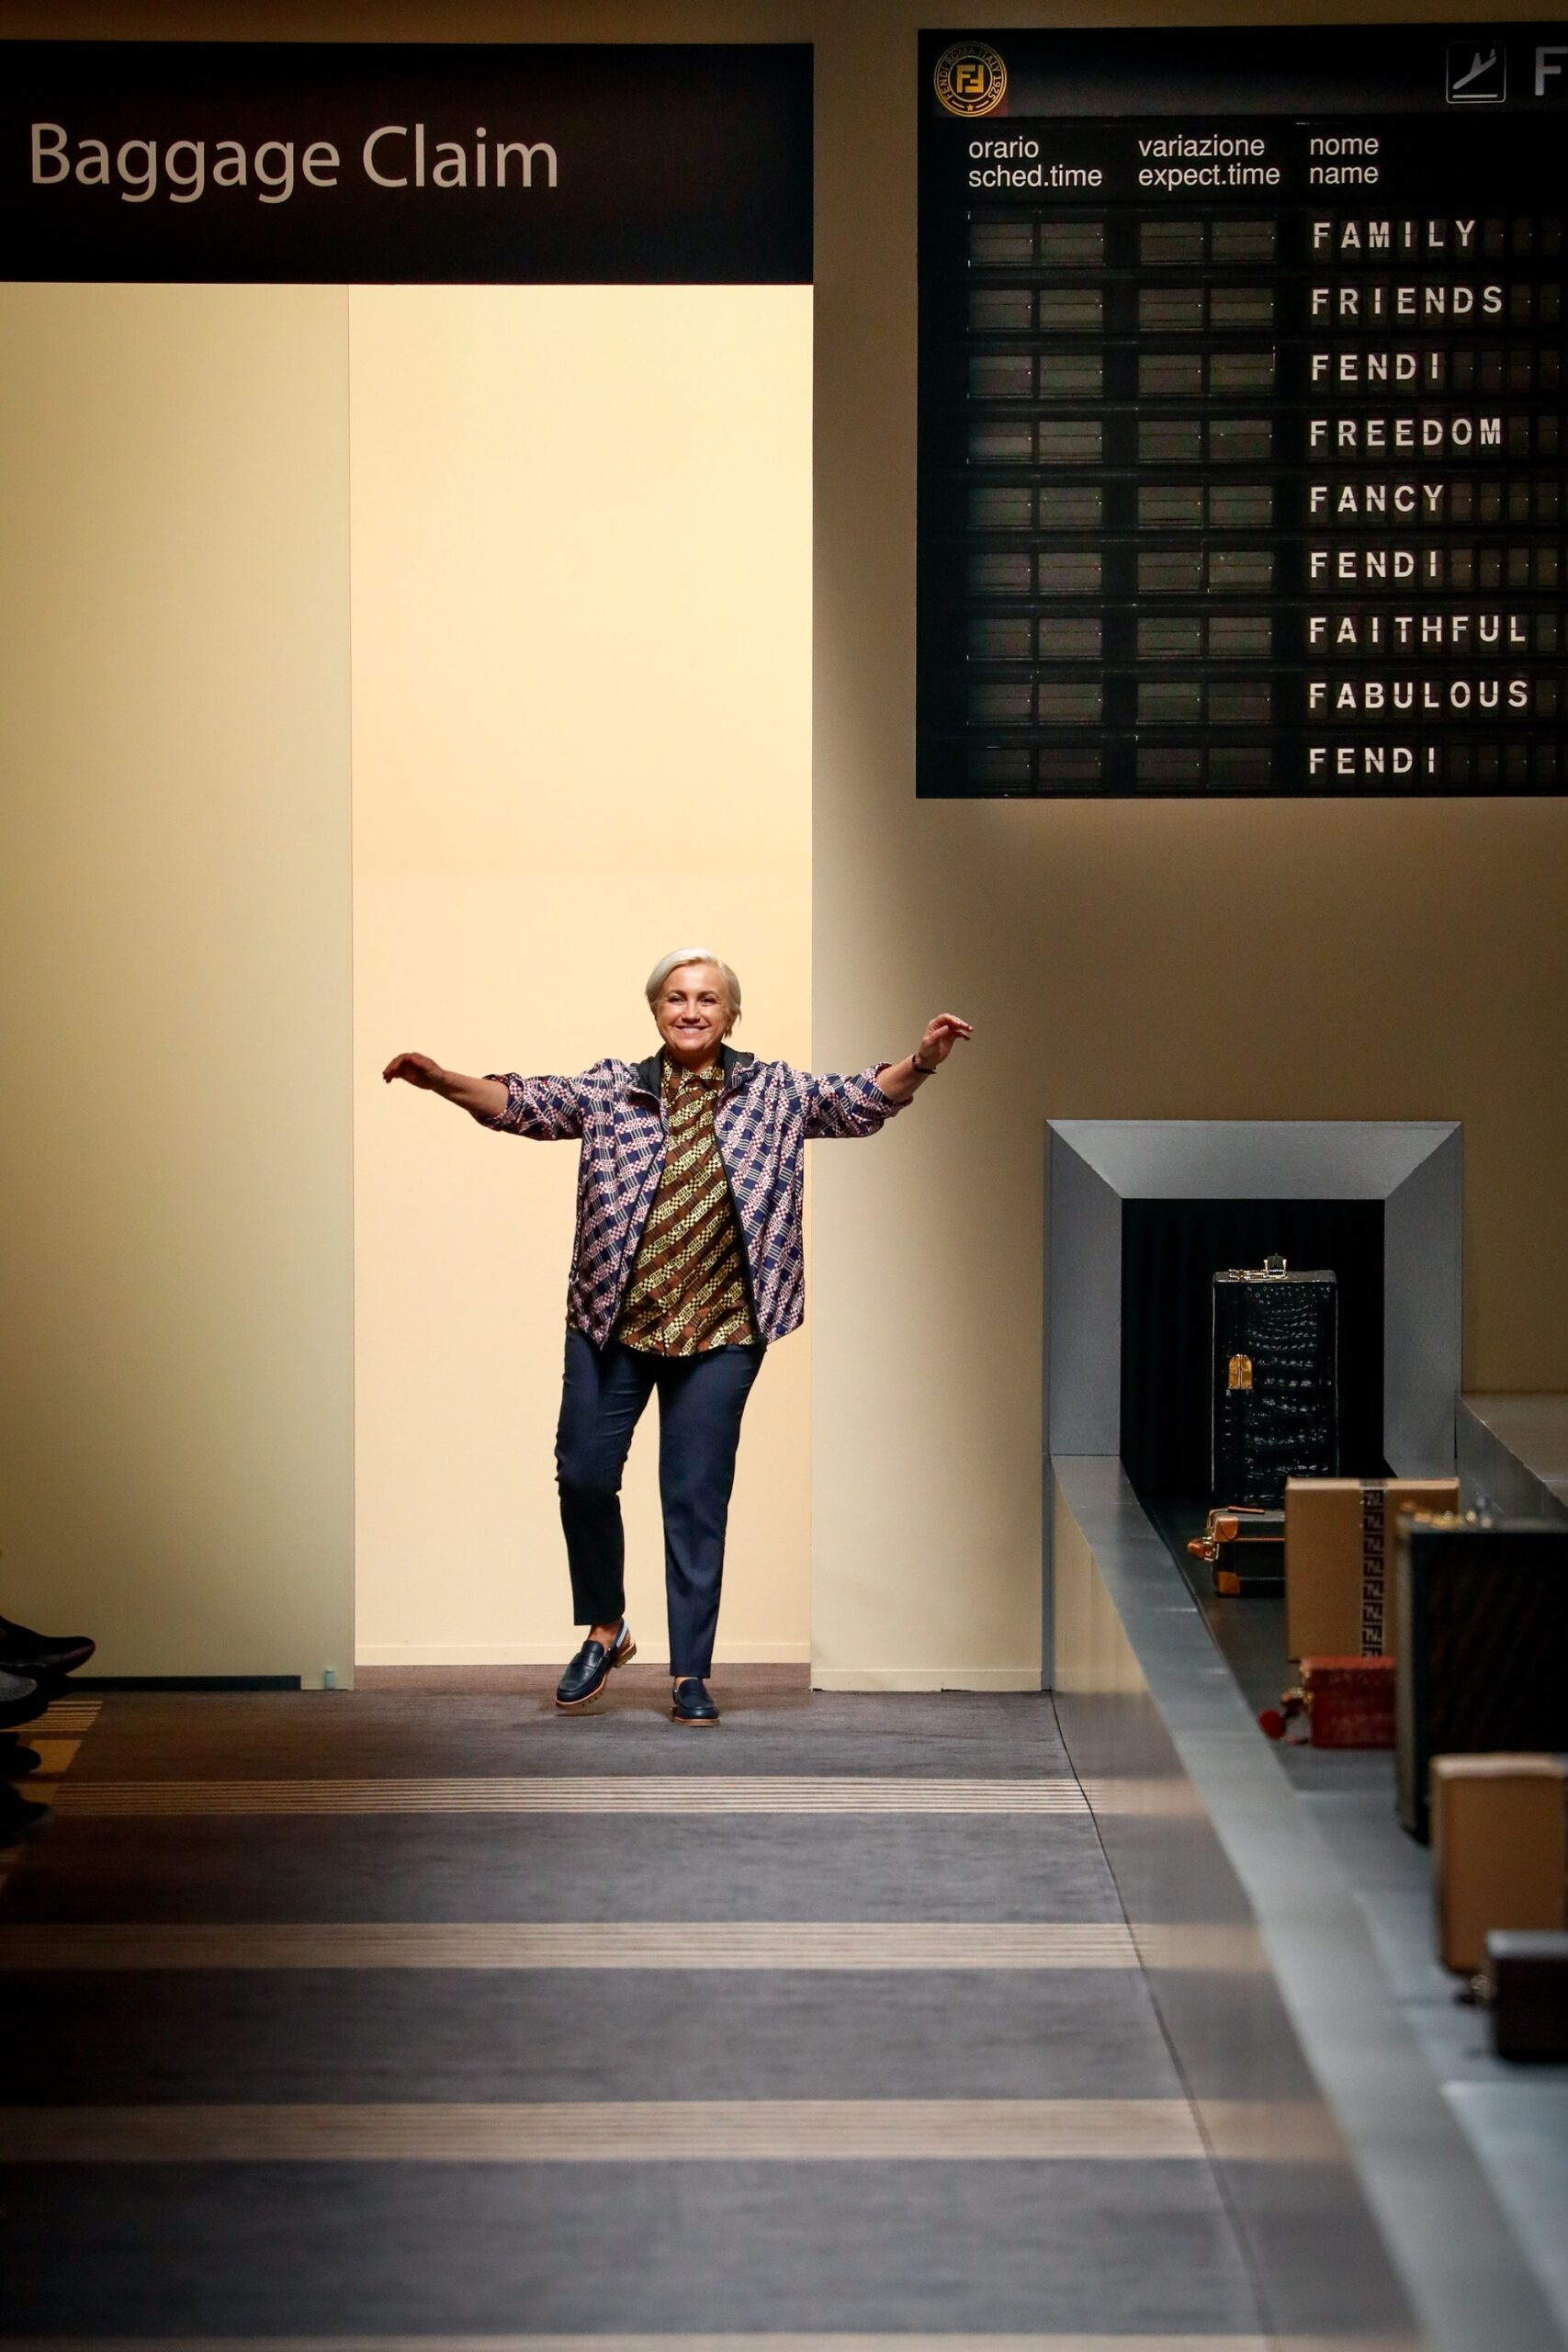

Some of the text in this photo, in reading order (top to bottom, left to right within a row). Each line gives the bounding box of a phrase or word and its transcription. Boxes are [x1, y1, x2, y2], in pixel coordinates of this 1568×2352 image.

[978, 48, 1001, 73] ITALY
[1534, 46, 1568, 96] F
[939, 66, 953, 101] FENDI
[987, 75, 1002, 101] 1925
[968, 135, 1039, 159] orario
[1138, 133, 1265, 157] variazione
[1310, 138, 1379, 156] nome
[31, 122, 558, 204] Baggage Claim
[968, 164, 1102, 187] sched.time
[1310, 166, 1379, 185] name
[1138, 164, 1280, 191] expect.time
[1314, 220, 1475, 248] FAMILY
[1312, 286, 1502, 315] FRIENDS
[1312, 353, 1438, 381] FENDI
[1310, 418, 1501, 447] FREEDOM
[1310, 484, 1443, 513] FANCY
[1311, 550, 1437, 578] FENDI
[1310, 615, 1526, 643] FAITHFUL
[1309, 680, 1528, 709] FABULOUS
[1309, 747, 1435, 775] FENDI
